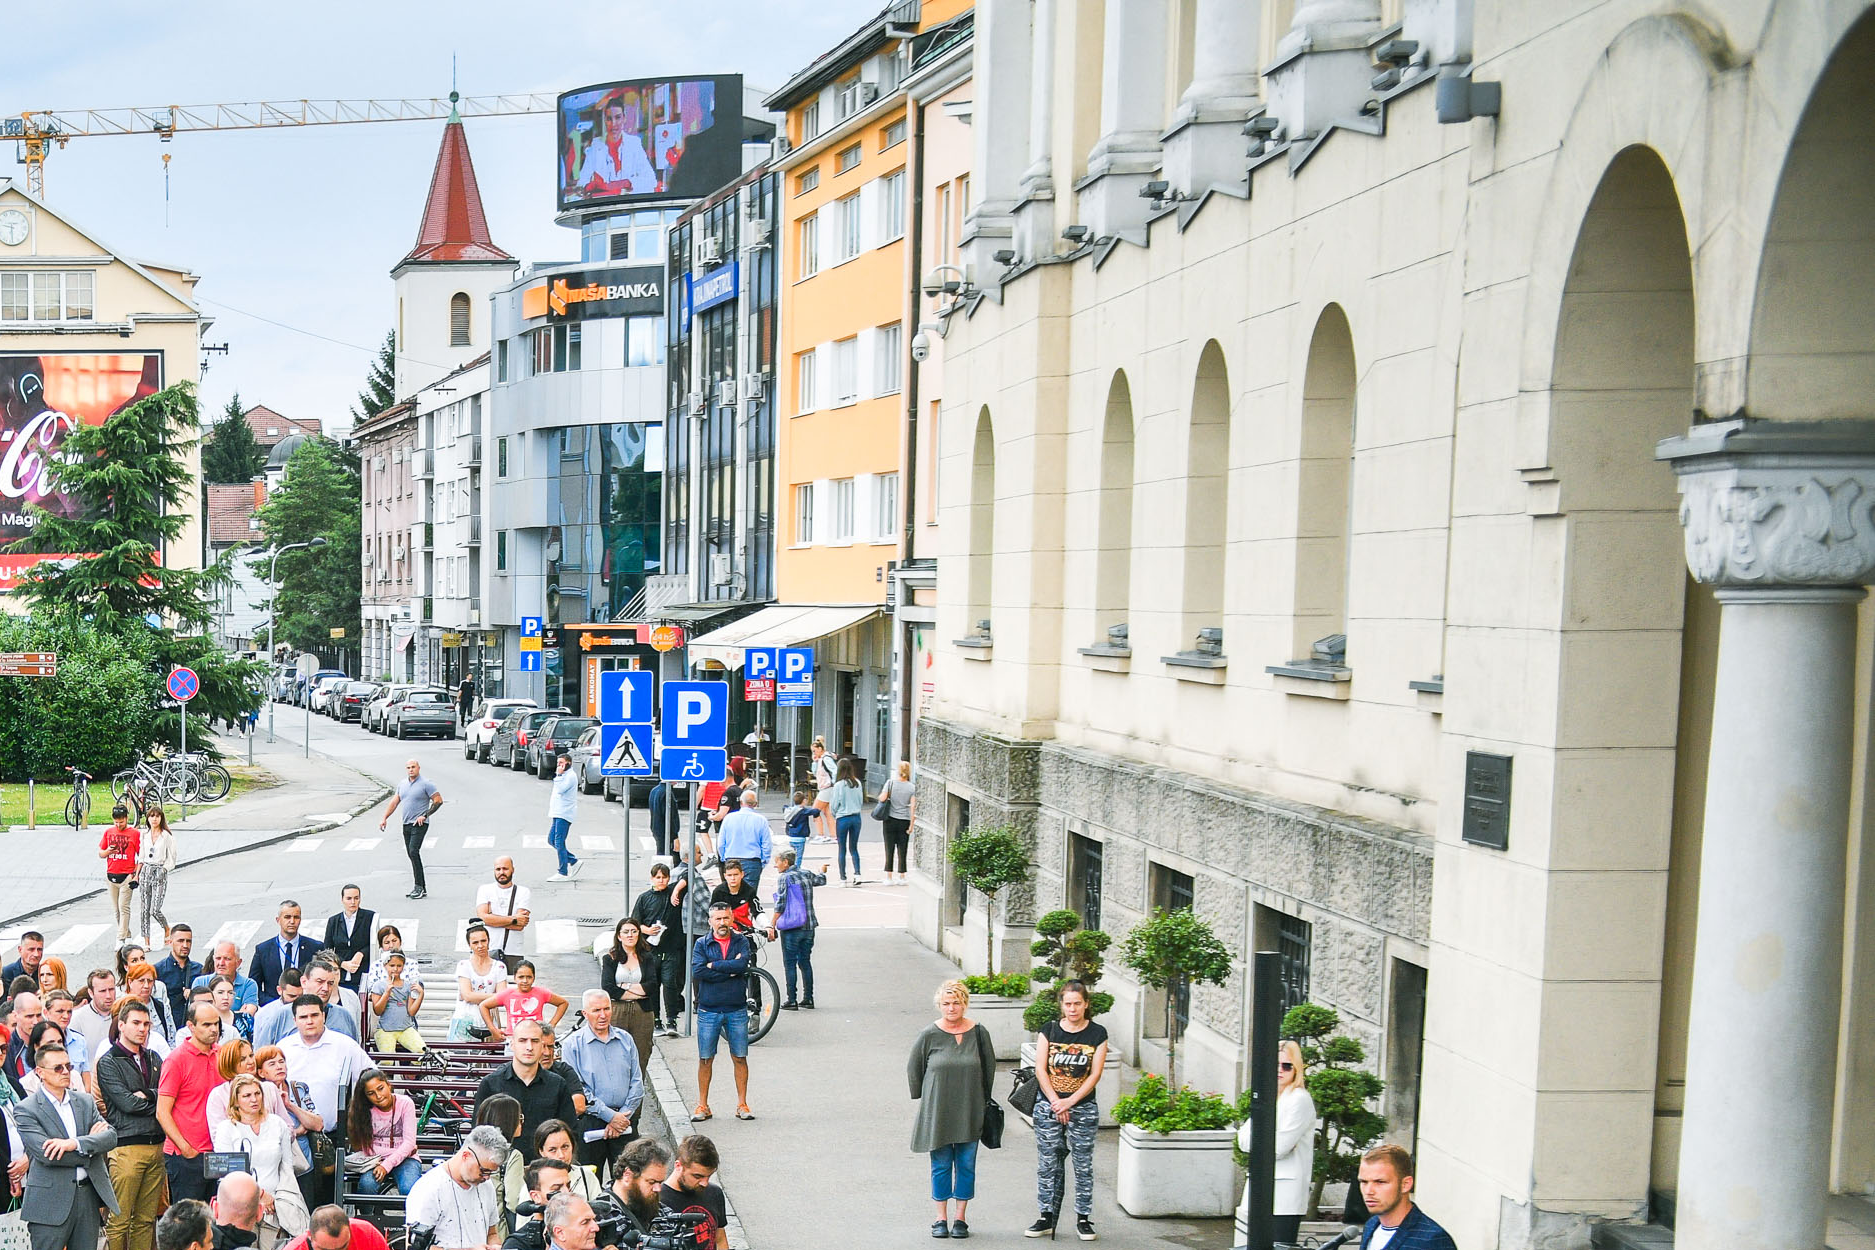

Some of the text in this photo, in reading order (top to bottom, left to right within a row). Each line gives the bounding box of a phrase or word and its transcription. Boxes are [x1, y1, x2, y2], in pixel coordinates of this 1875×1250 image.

[525, 619, 538, 635] P
[751, 652, 770, 676] P
[785, 653, 806, 679] P
[676, 691, 713, 739] P
[1053, 1053, 1088, 1066] WILD
